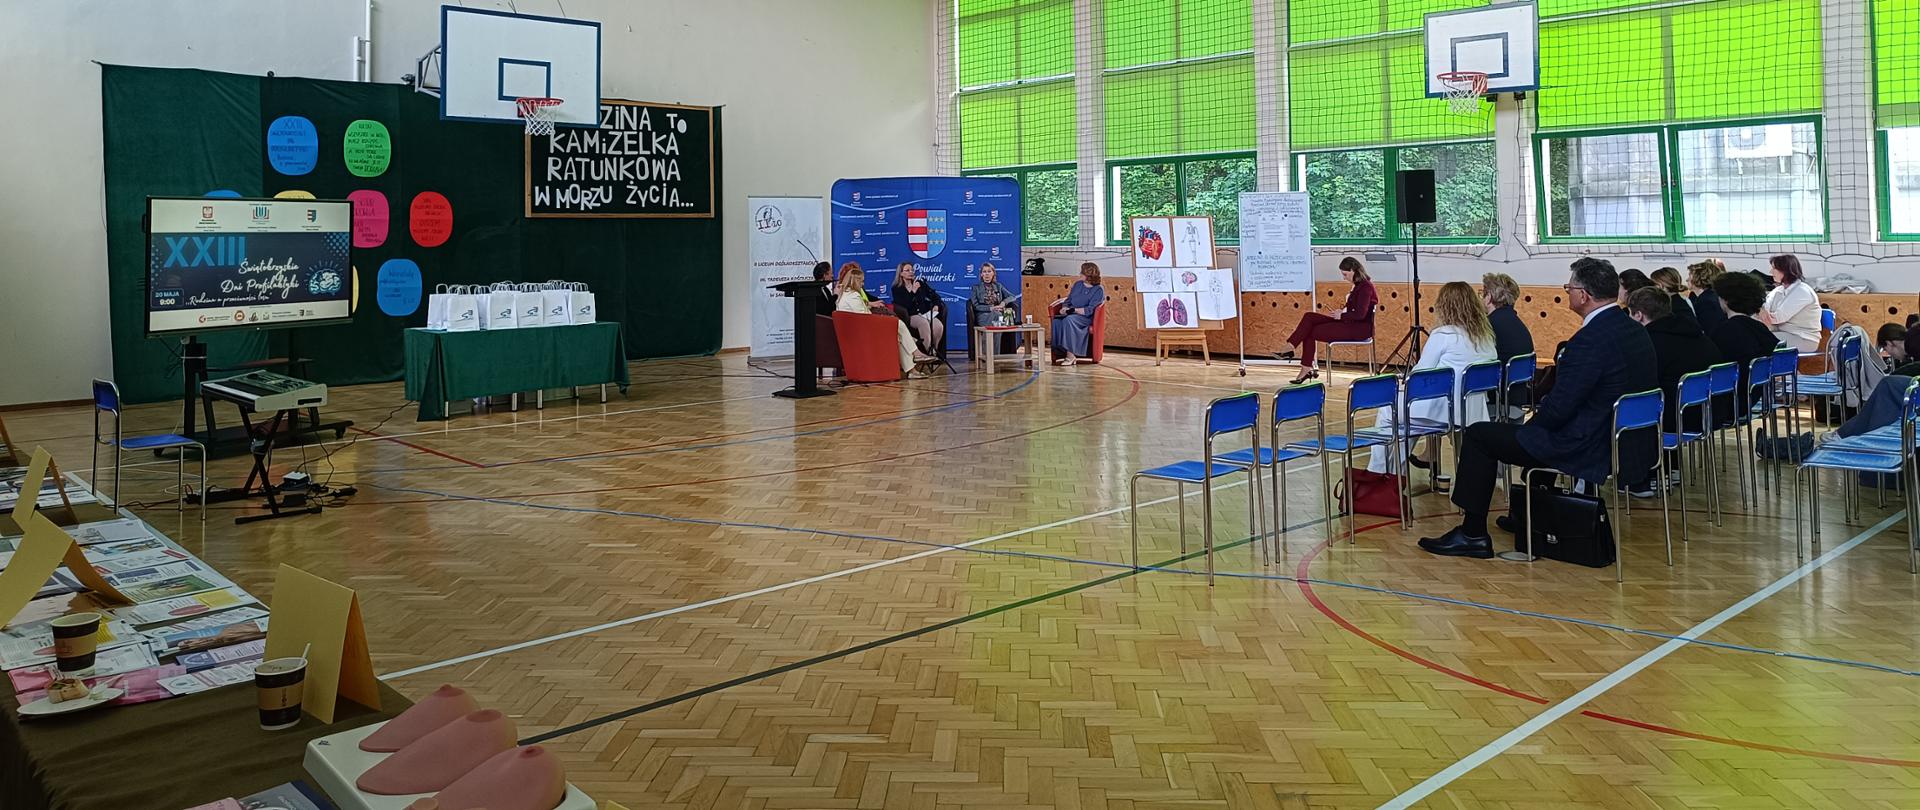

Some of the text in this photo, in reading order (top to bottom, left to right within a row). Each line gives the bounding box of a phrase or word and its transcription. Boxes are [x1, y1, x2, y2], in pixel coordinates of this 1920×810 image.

[547, 156, 681, 181] RATUNKOWA
[534, 185, 550, 206] W
[556, 183, 613, 210] MORZU
[163, 236, 247, 268] XXIII
[220, 279, 243, 293] Dni
